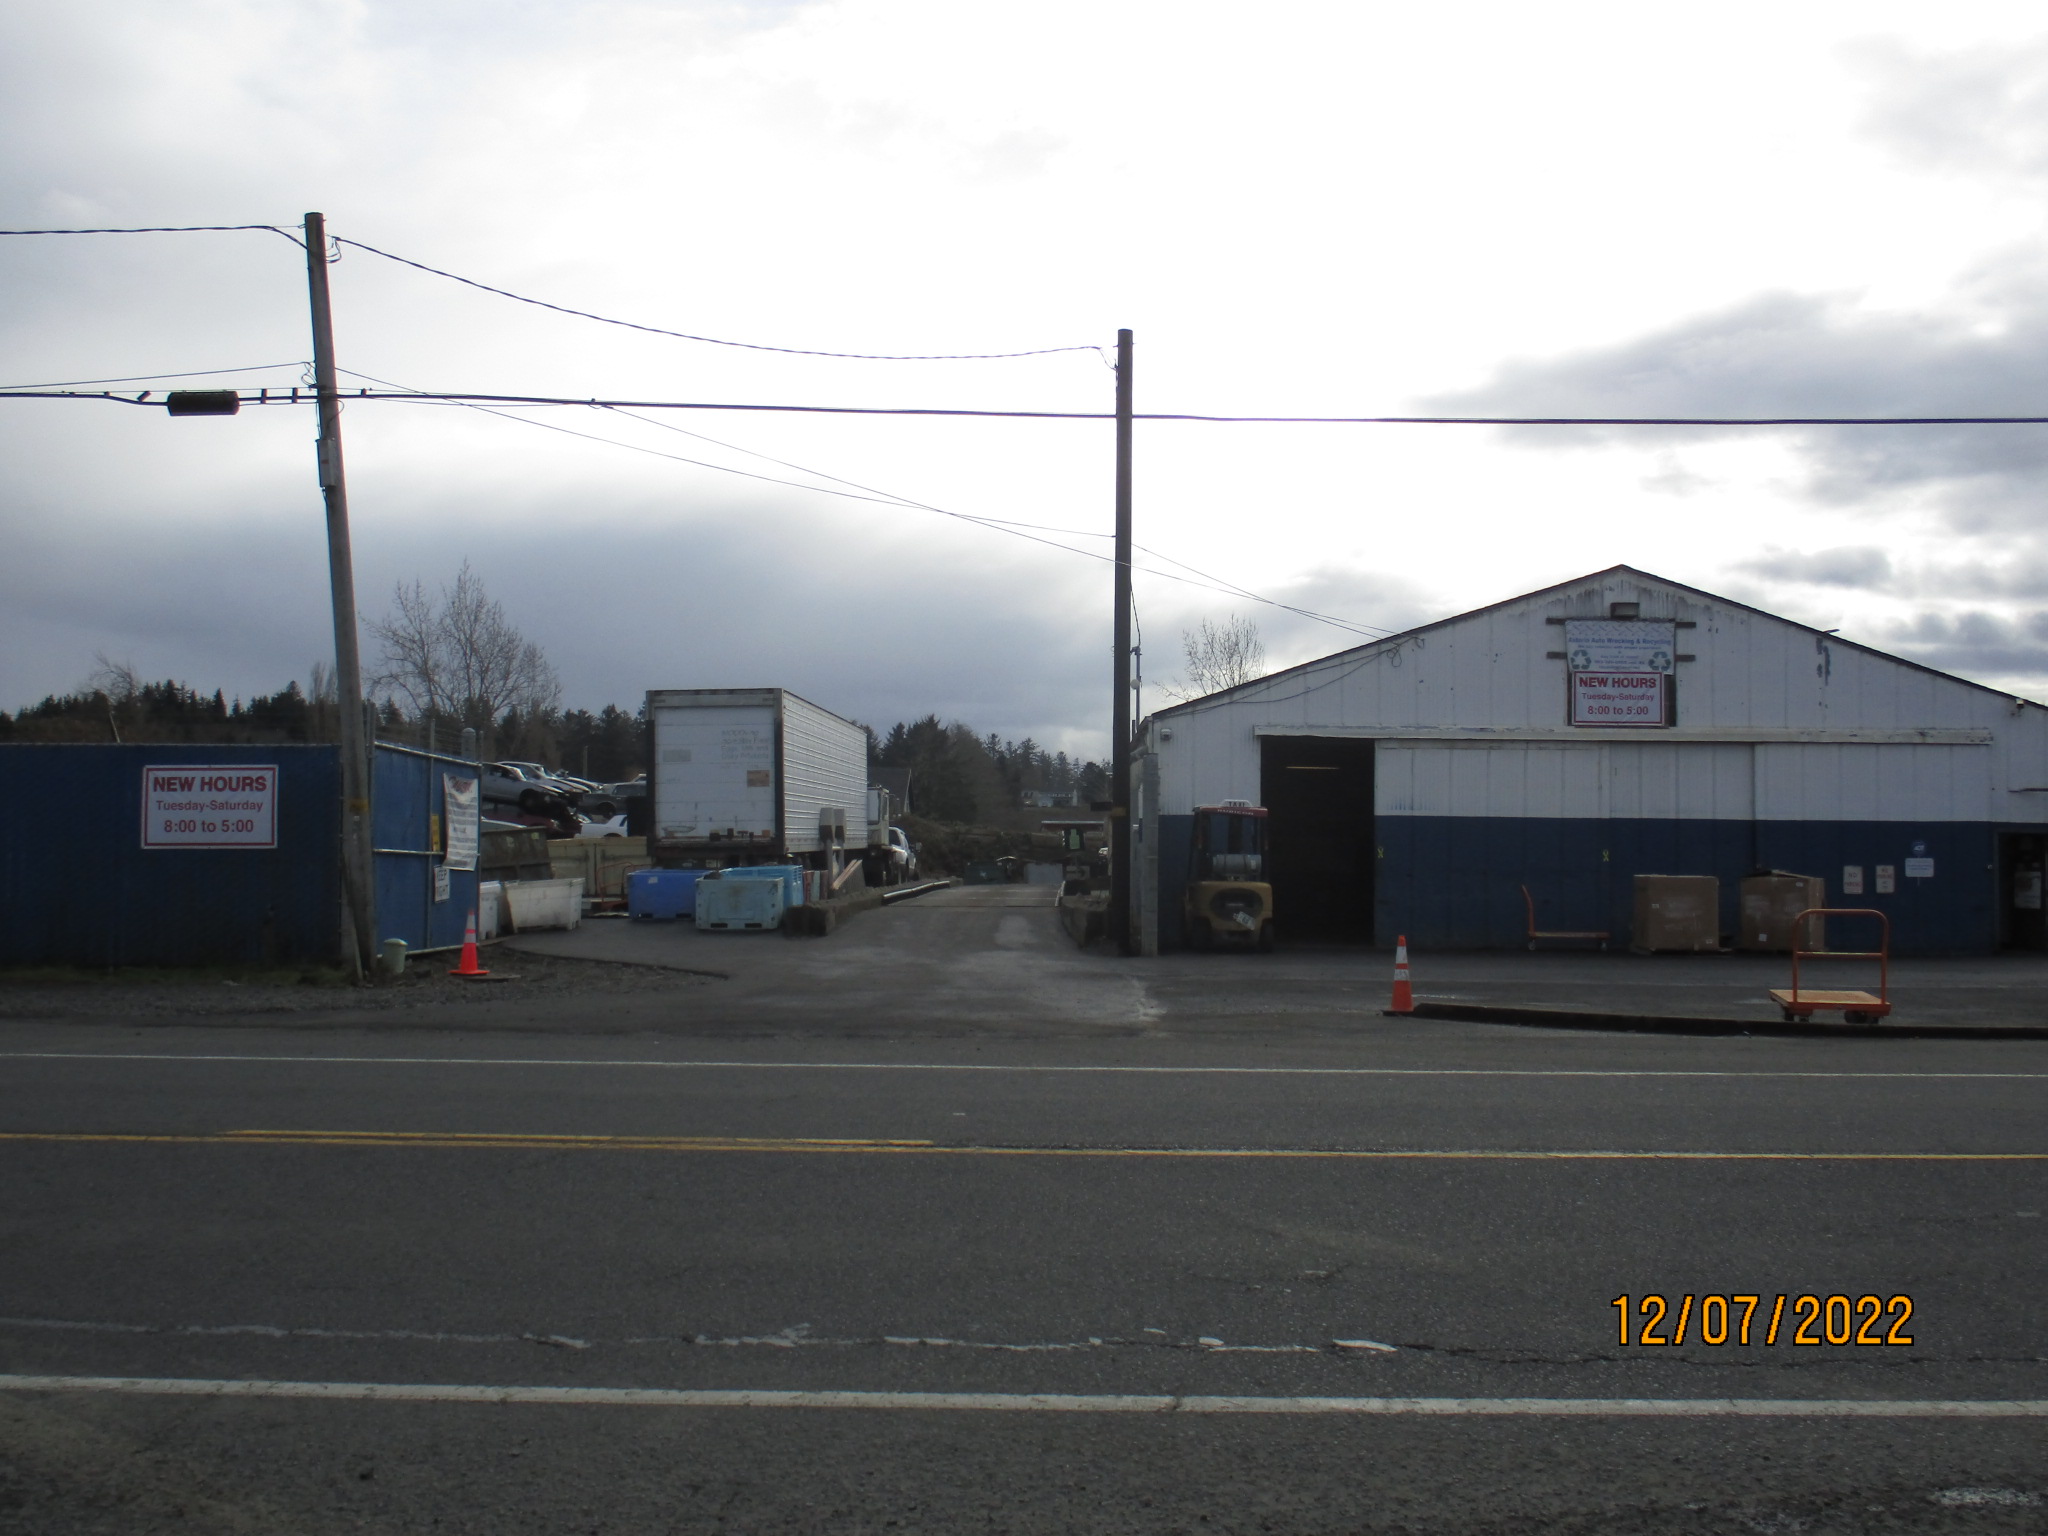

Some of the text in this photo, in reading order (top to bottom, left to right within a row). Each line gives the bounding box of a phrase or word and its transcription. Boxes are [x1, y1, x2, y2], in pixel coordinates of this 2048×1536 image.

[1606, 637, 1635, 645] Wrecking
[1579, 677, 1657, 689] NEW HOURS
[1581, 692, 1655, 702] Tuesday-Saturday
[1587, 705, 1649, 715] 8:00 to 5:00
[153, 776, 267, 792] NEW HOURS
[156, 800, 264, 812] Tuesday-Saturday
[164, 819, 254, 832] 8:00 to 5:00
